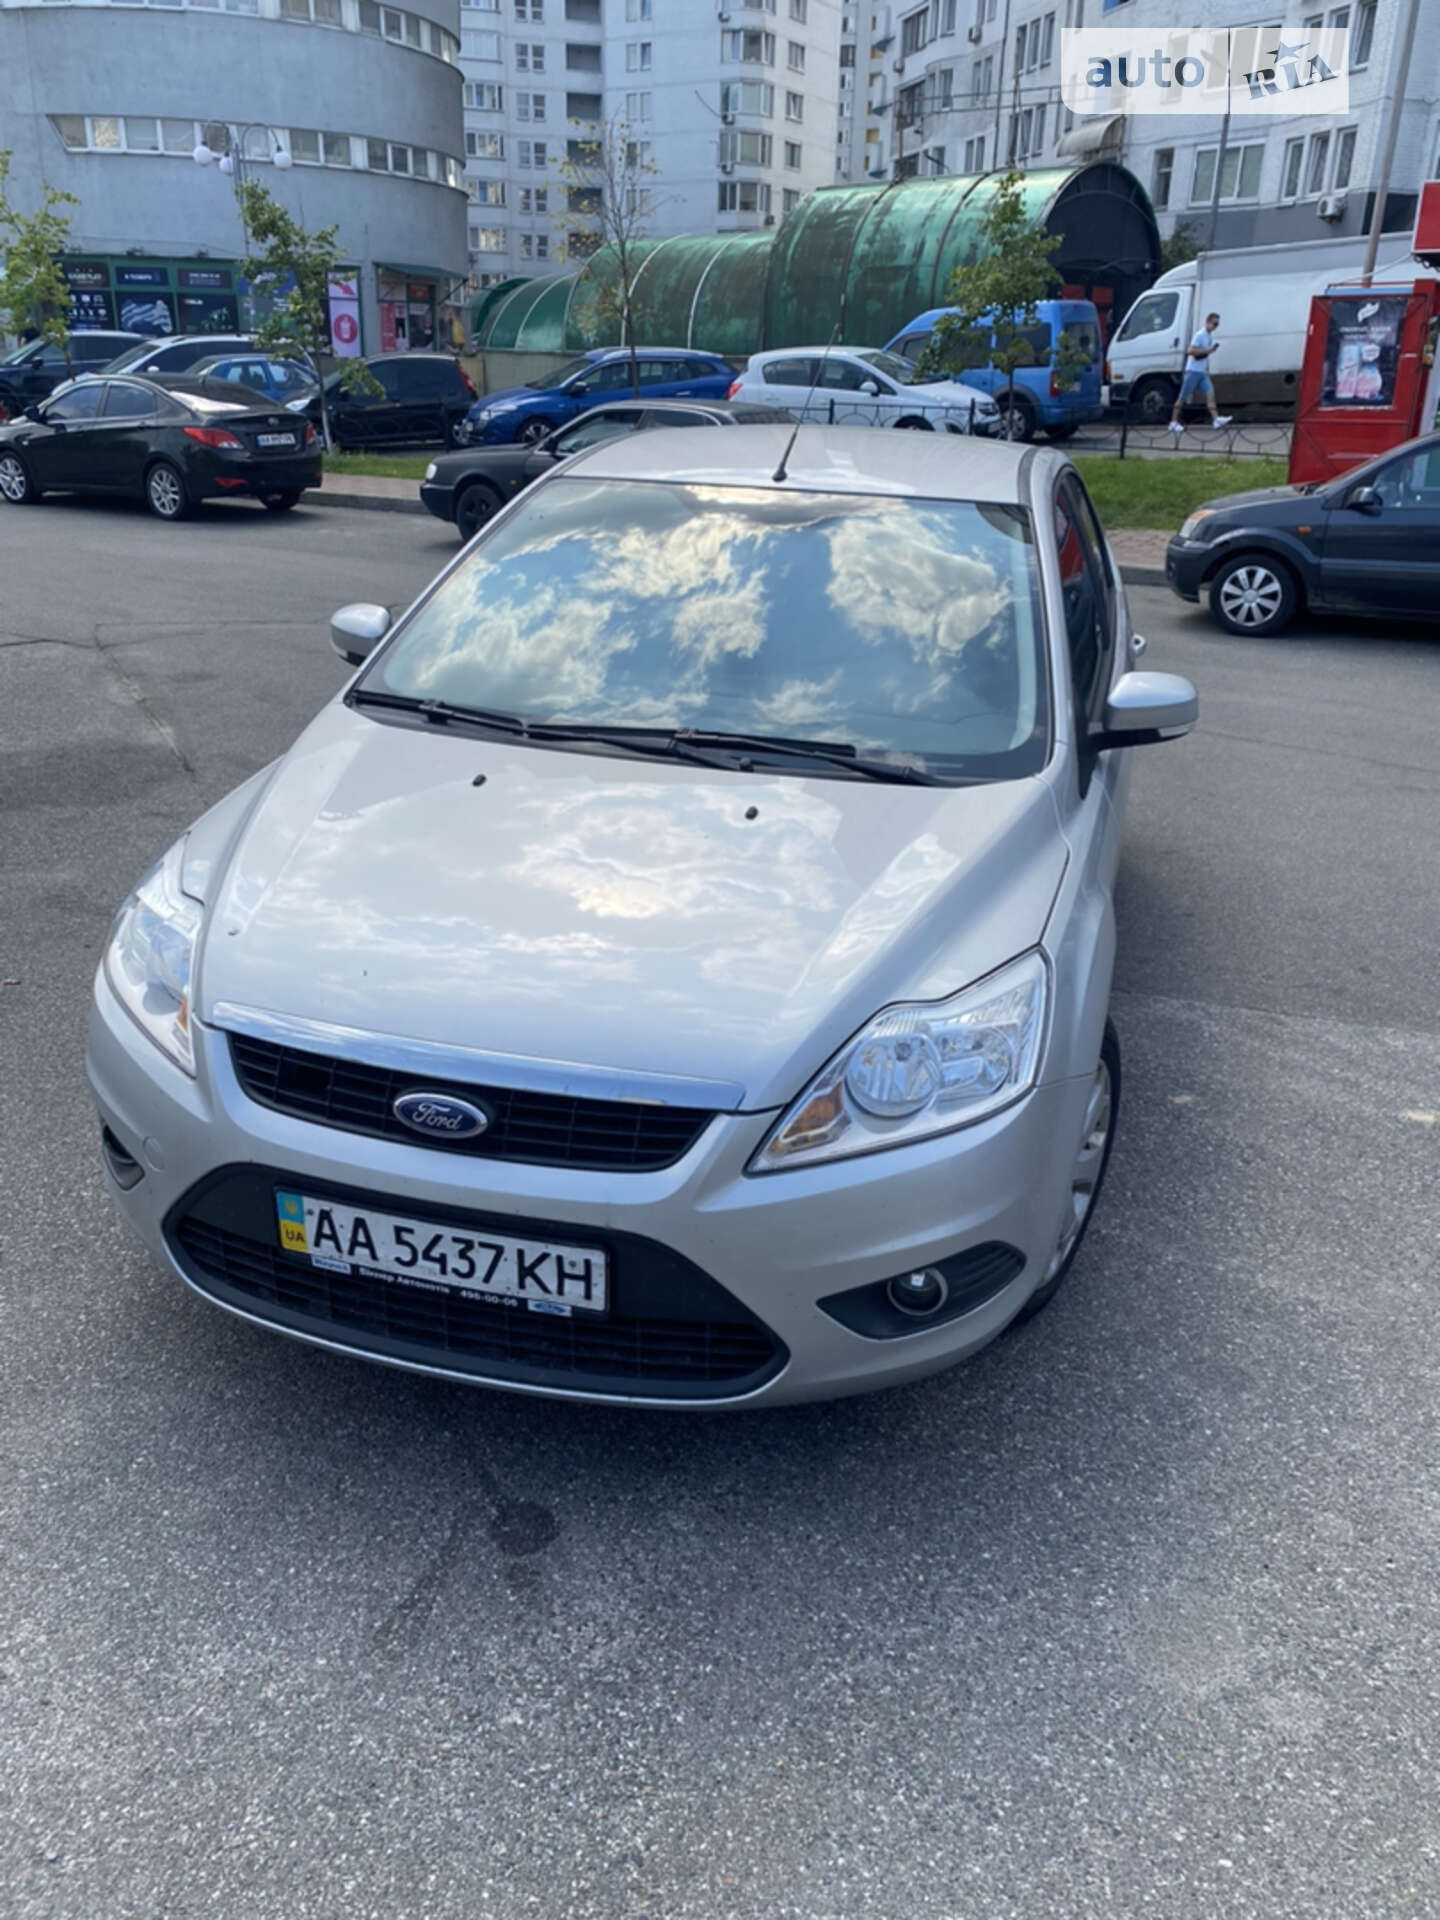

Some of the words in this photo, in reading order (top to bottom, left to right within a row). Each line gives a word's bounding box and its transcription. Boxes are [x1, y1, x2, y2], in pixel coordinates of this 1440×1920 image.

[412, 1103, 463, 1130] Ford
[285, 1229, 305, 1243] UA
[313, 1208, 379, 1261] AA
[393, 1225, 506, 1285] 5437
[516, 1248, 593, 1301] KH
